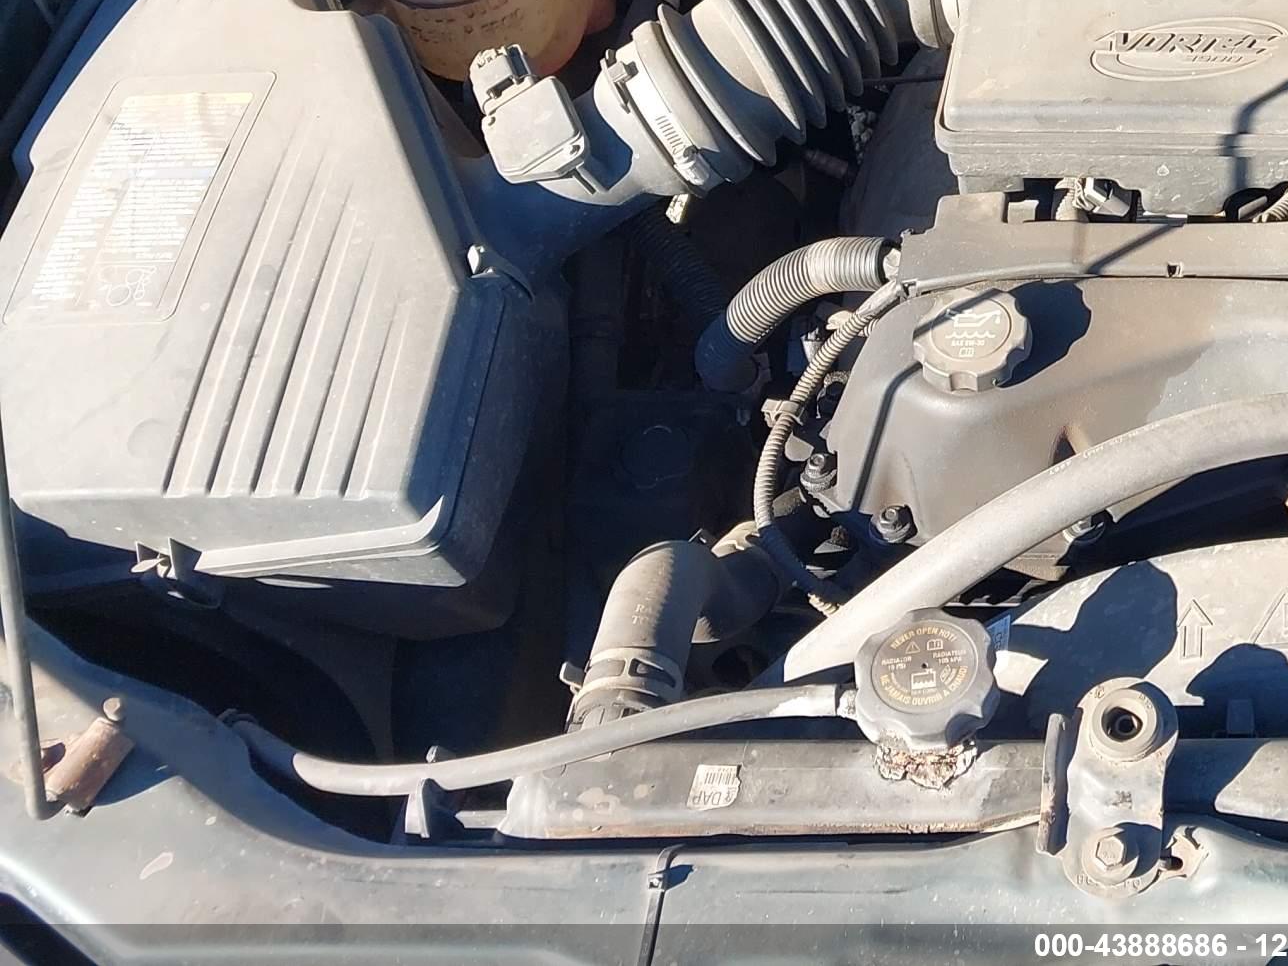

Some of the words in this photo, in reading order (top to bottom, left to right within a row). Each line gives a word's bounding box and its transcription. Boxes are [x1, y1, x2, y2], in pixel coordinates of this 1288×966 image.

[1110, 32, 1279, 55] VORTEC
[890, 630, 915, 650] NEVER
[916, 626, 938, 636] OPEN
[884, 683, 911, 705] JAMAIS
[911, 693, 943, 706] OUVRIR
